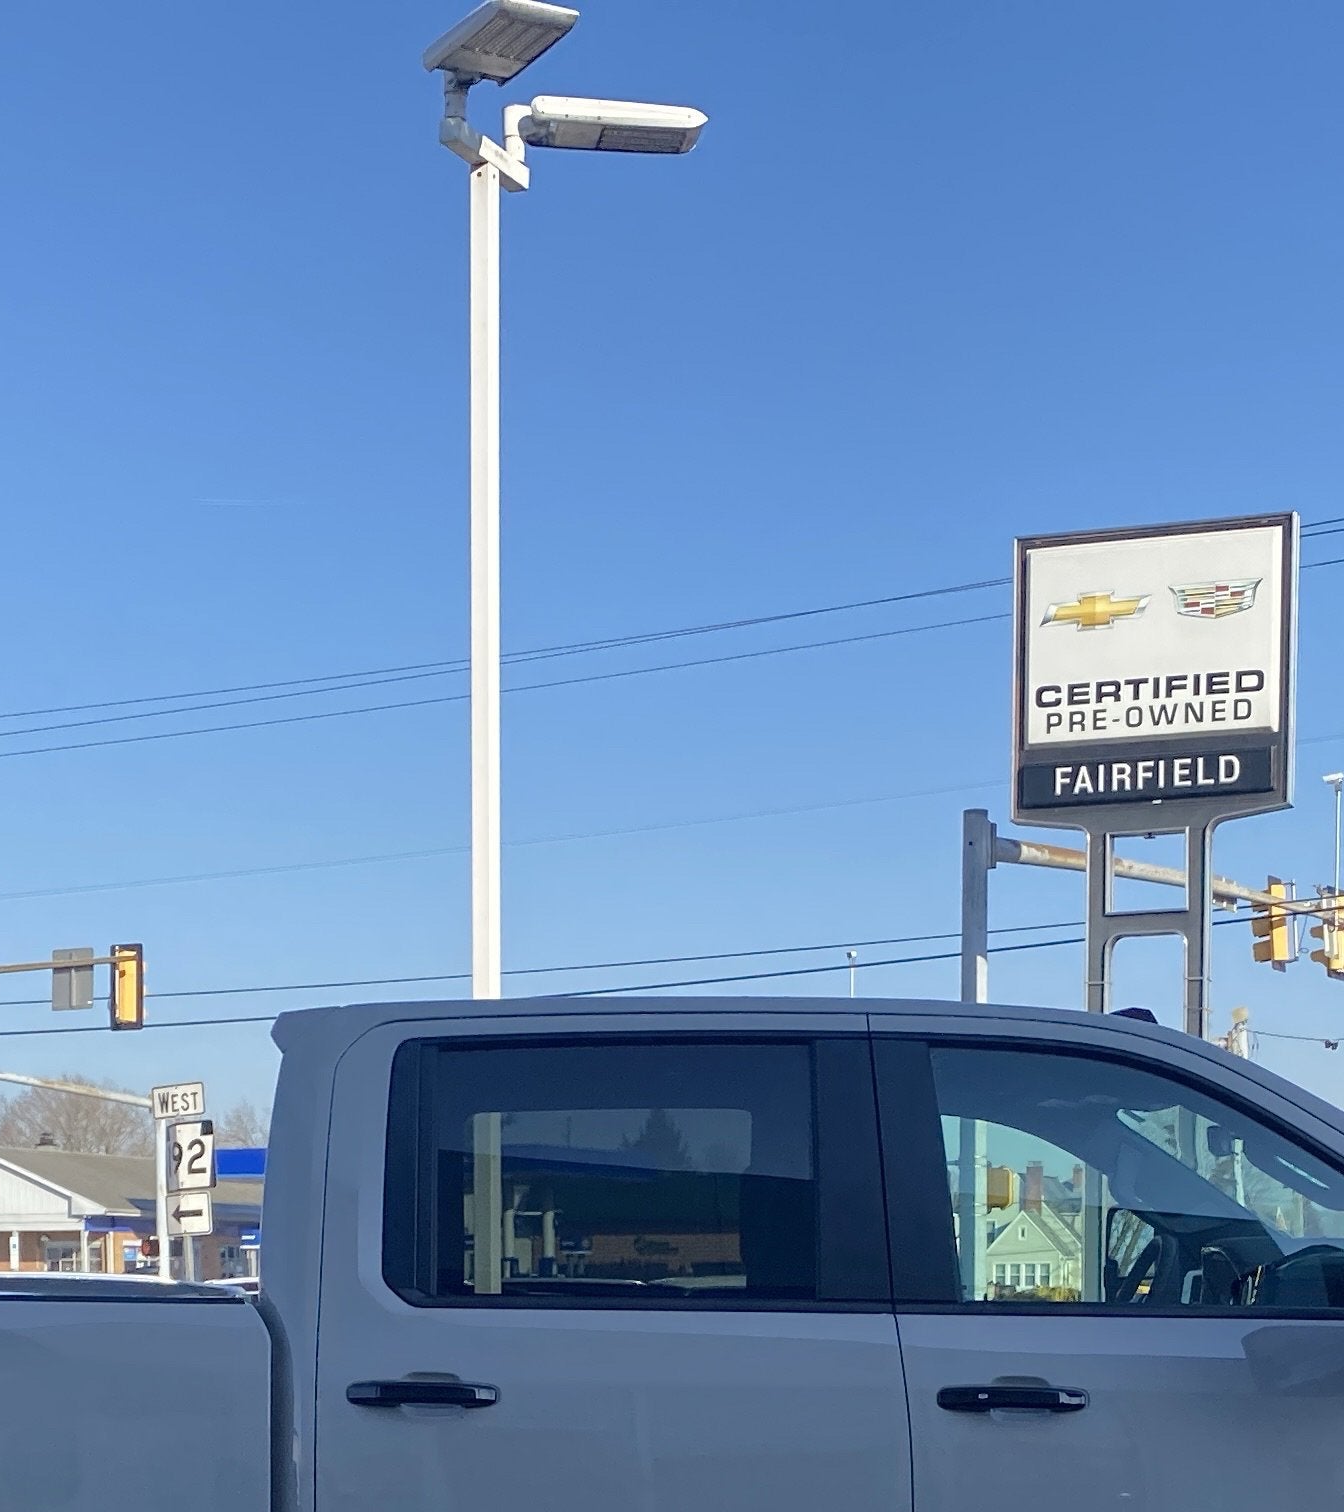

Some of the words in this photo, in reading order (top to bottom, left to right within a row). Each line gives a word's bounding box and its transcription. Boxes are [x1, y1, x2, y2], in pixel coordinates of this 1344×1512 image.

[1035, 669, 1265, 708] CERTIFIED
[1046, 698, 1252, 734] PRE-OWNED
[1054, 754, 1241, 797] FAIRFIELD
[158, 1091, 198, 1114] WEST
